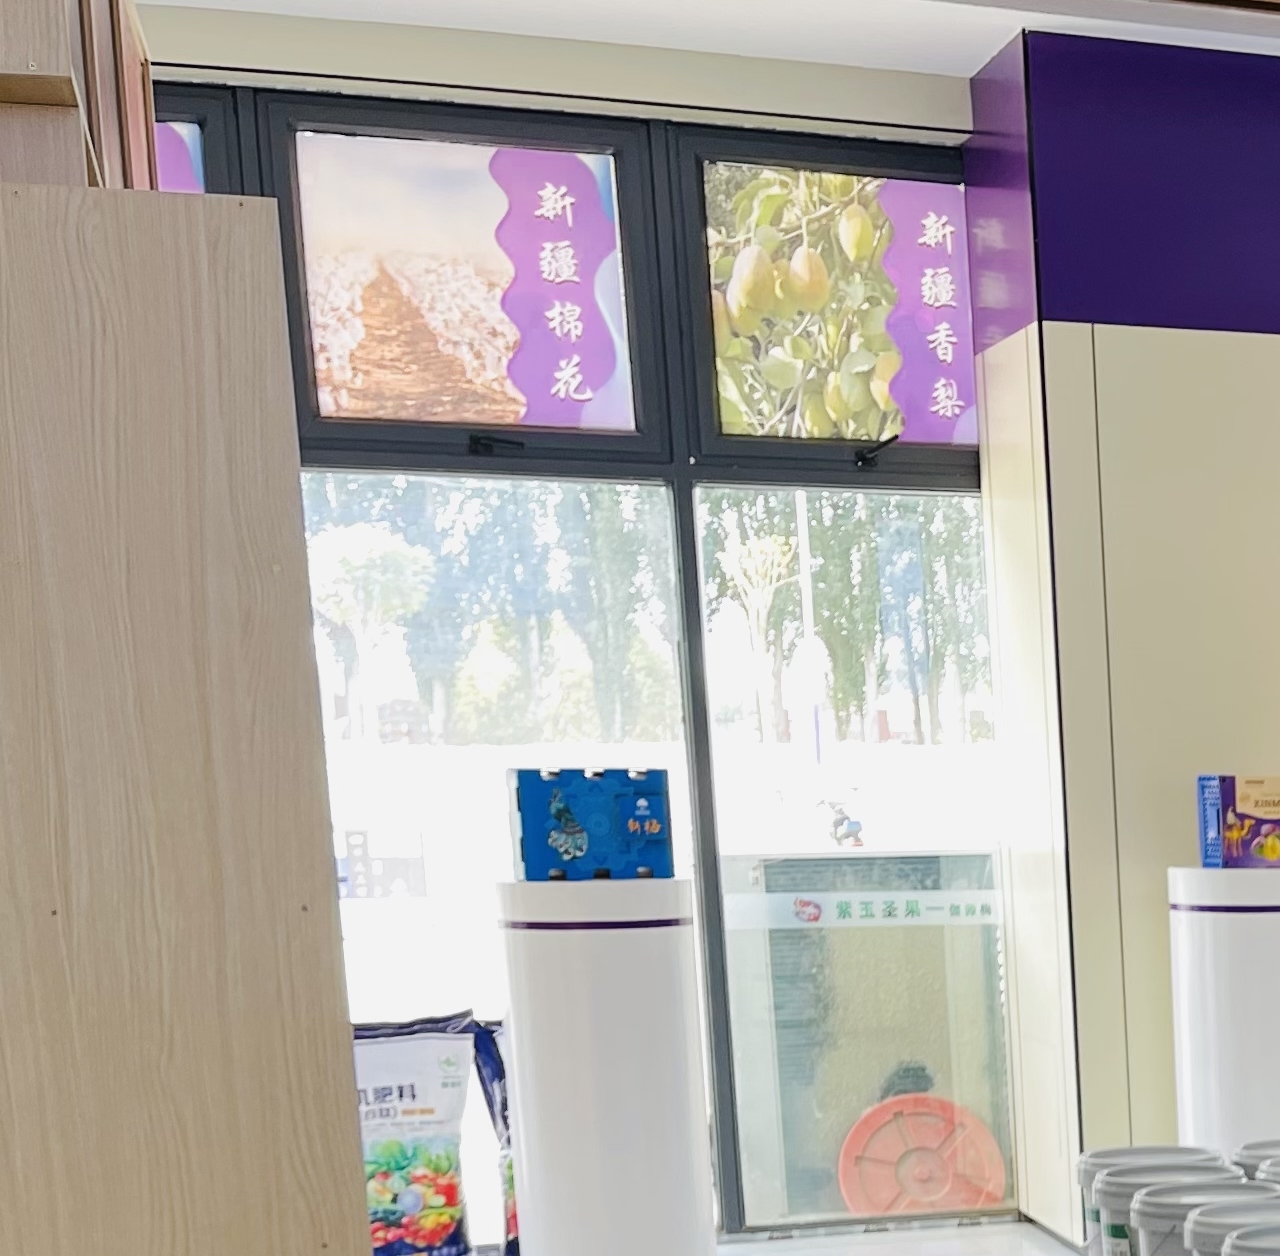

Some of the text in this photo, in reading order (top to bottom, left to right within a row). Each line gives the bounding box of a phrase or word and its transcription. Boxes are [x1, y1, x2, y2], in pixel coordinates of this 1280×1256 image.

[534, 181, 594, 402] 新疆棉花
[916, 210, 966, 420] 新疆香梨
